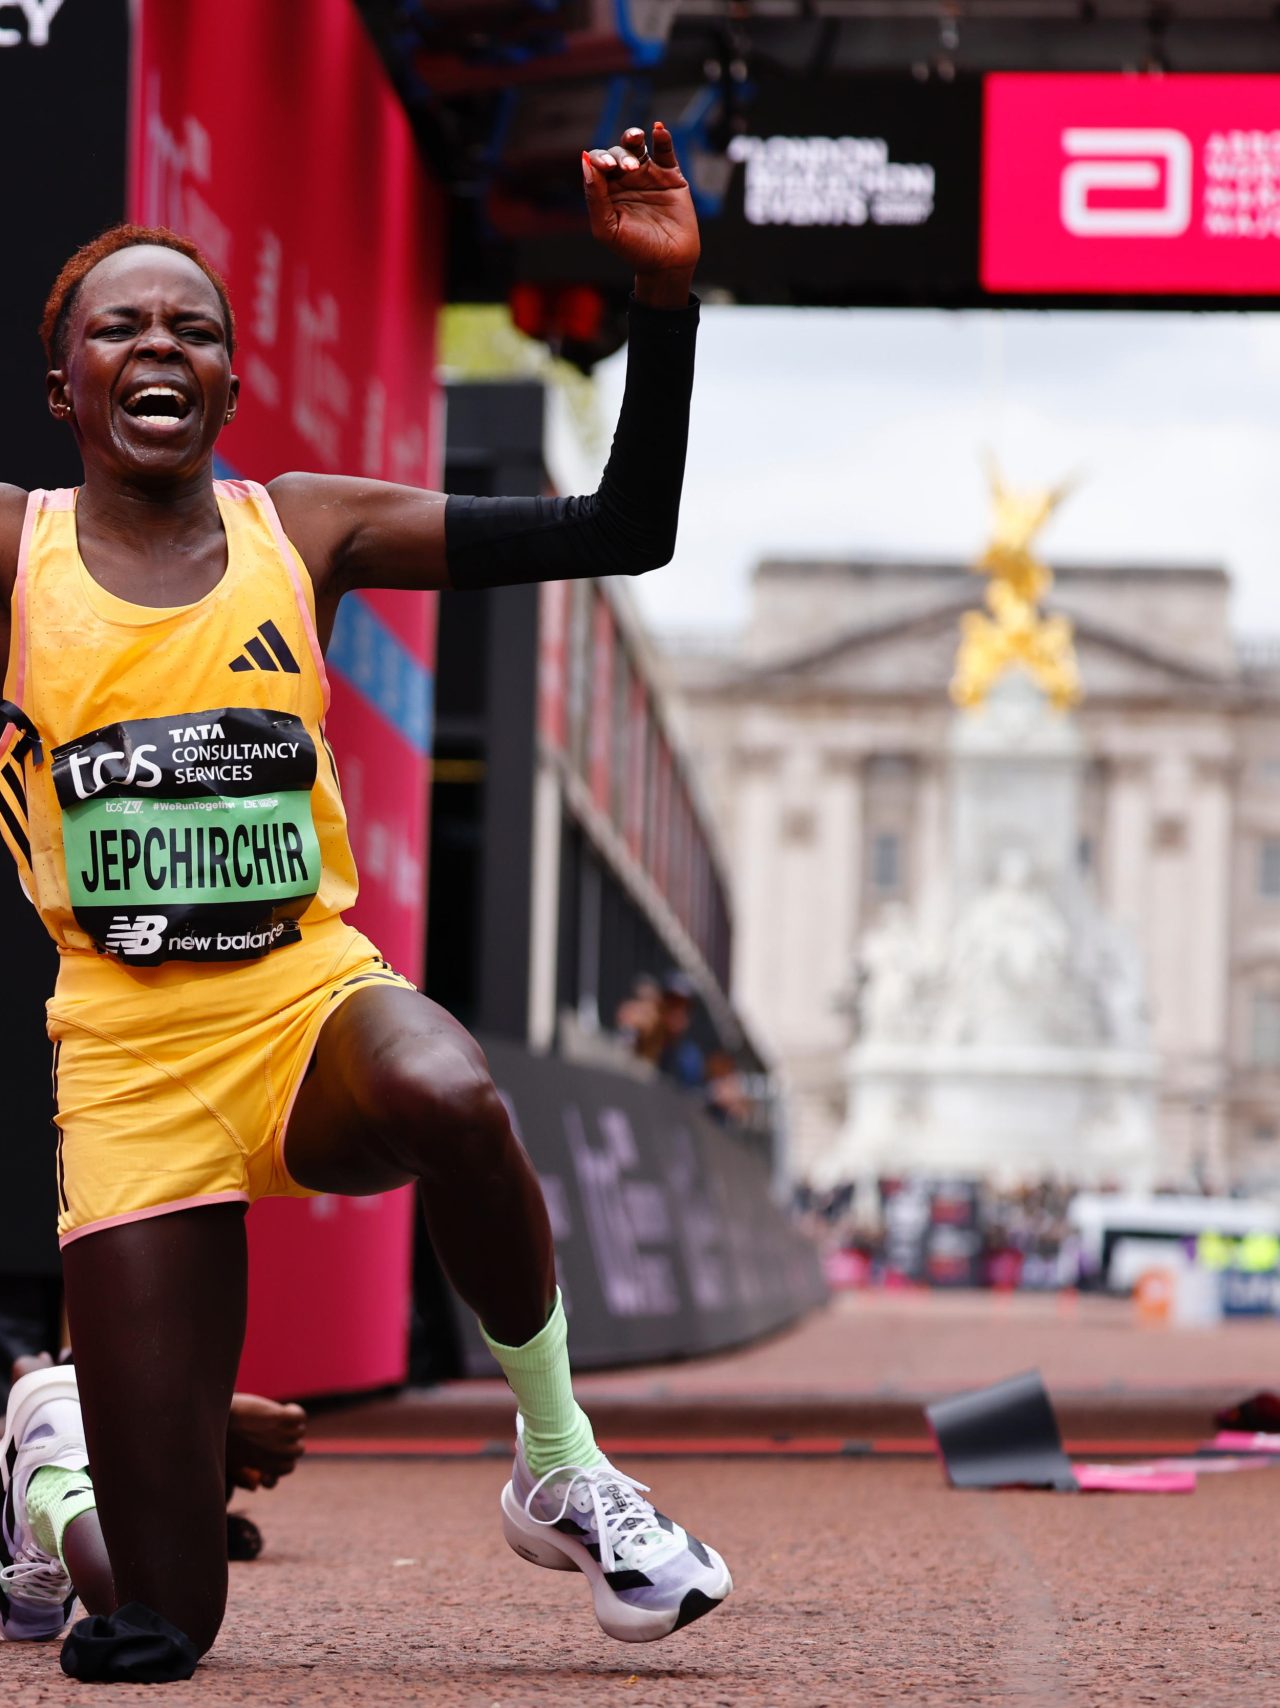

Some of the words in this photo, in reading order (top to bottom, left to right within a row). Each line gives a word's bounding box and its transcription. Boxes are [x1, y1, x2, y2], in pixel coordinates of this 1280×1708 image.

[168, 723, 226, 744] TATA
[172, 742, 300, 764] CONSULTANCY
[69, 744, 163, 800] tcs
[175, 764, 253, 785] SERVICES
[81, 821, 309, 893] JEPCHIRCHIR
[105, 914, 169, 956] NB
[168, 935, 212, 951] new
[216, 922, 285, 951] balance
